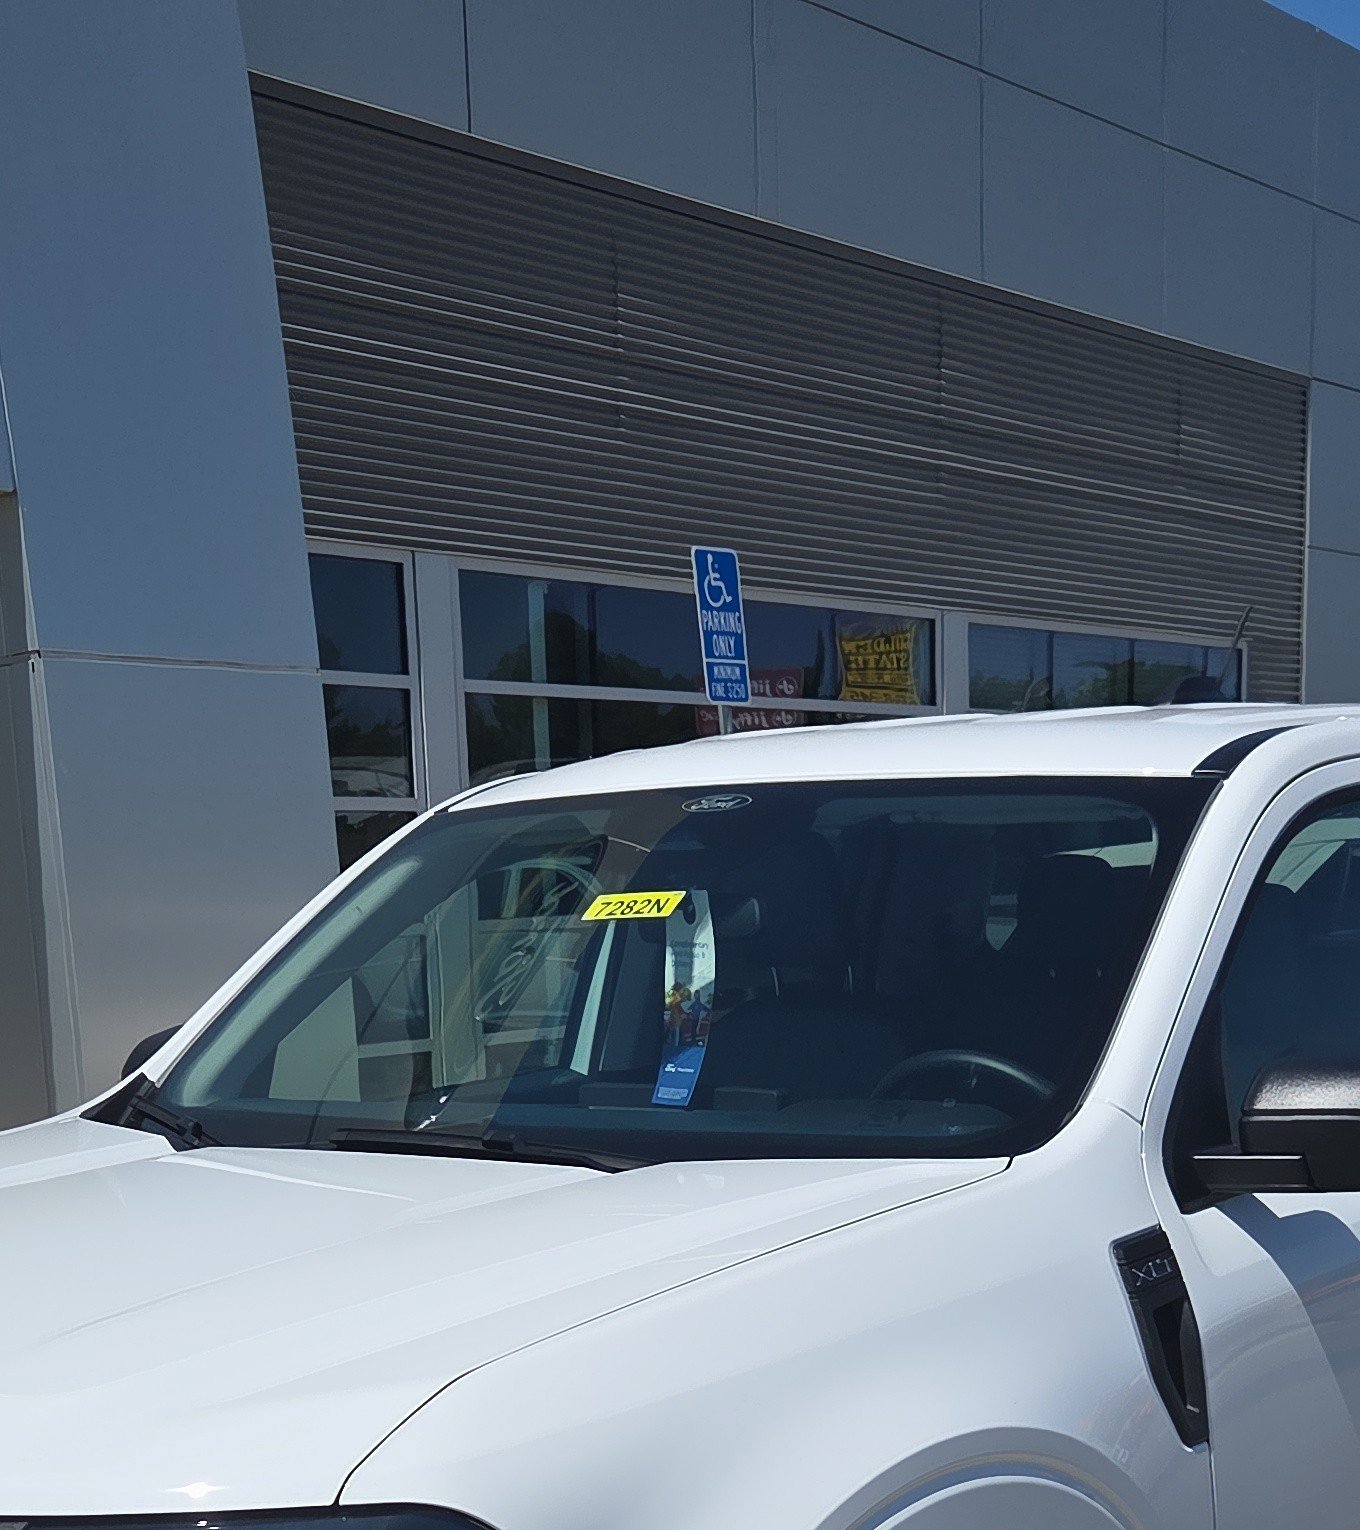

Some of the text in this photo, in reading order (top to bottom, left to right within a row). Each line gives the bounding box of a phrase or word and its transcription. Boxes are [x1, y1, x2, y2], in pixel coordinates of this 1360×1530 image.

[702, 609, 742, 634] PARKING
[712, 633, 736, 657] ONLY
[711, 682, 726, 698] FINE
[594, 897, 671, 918] 7282N
[1131, 1256, 1174, 1286] XLT
